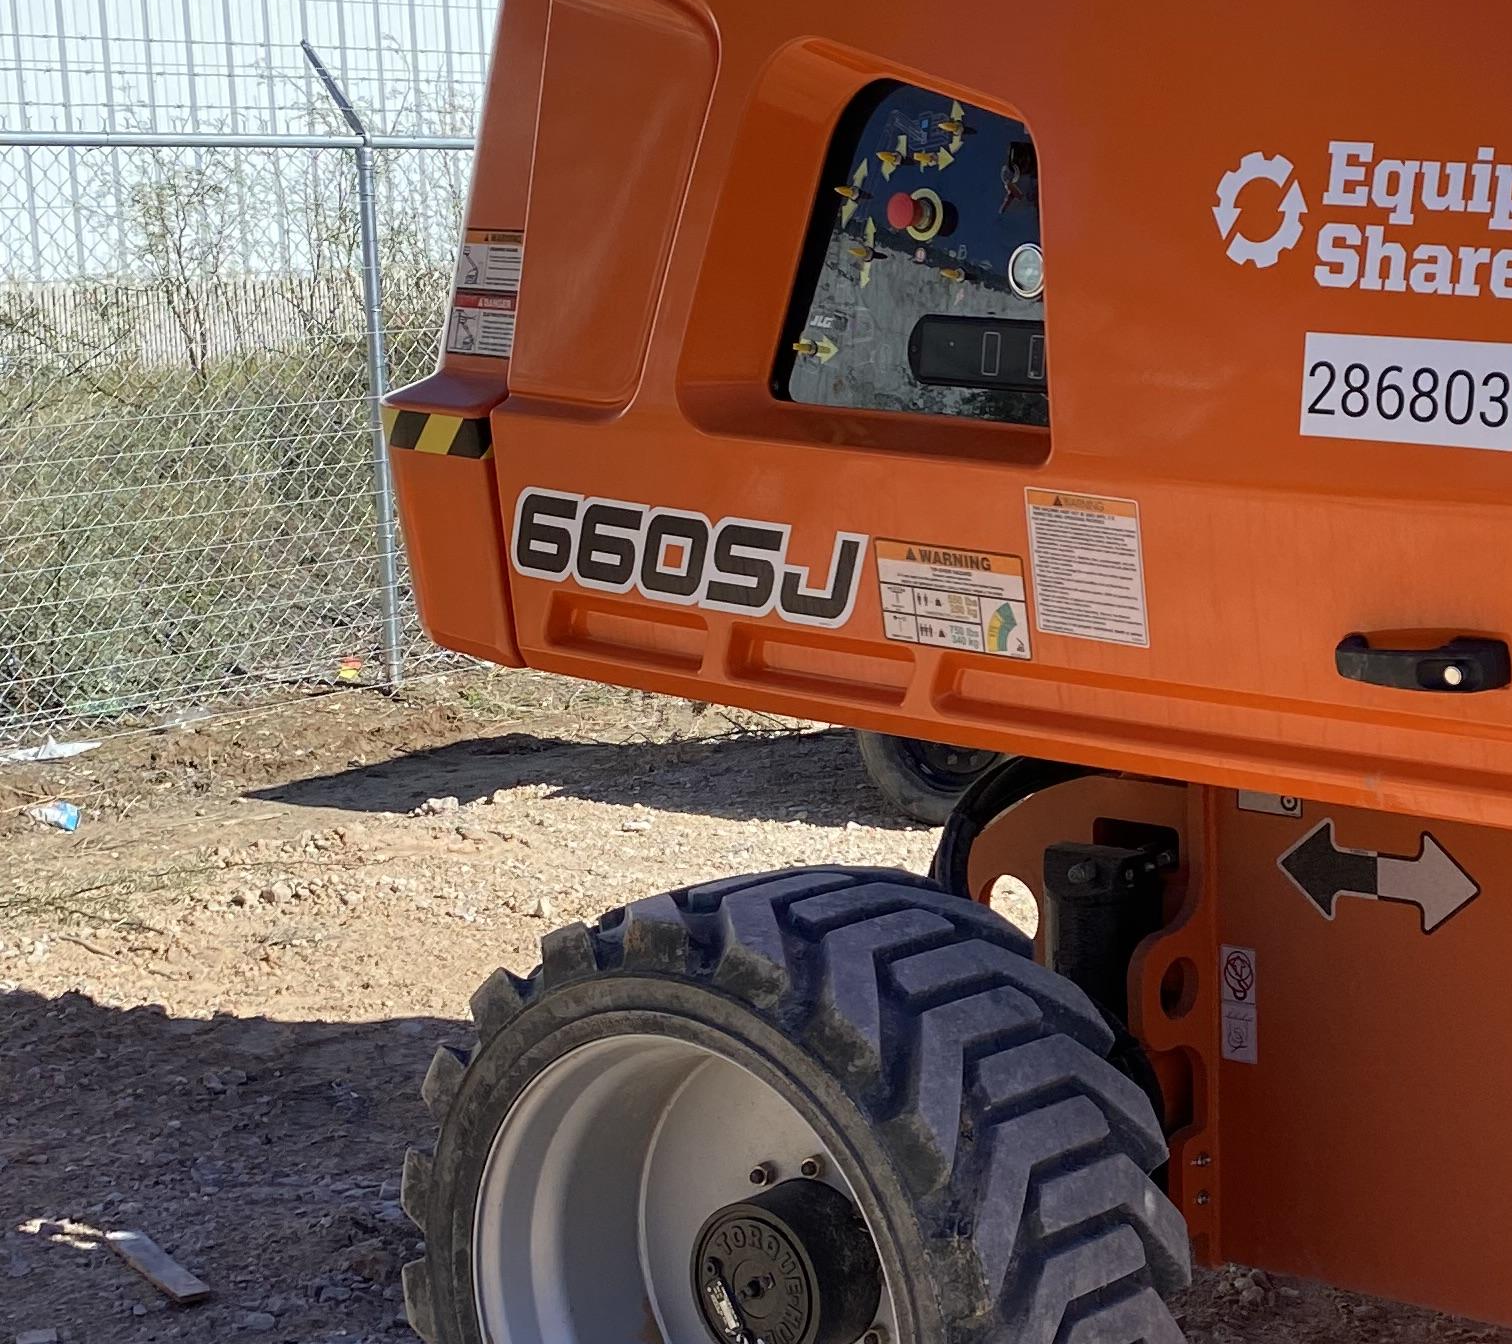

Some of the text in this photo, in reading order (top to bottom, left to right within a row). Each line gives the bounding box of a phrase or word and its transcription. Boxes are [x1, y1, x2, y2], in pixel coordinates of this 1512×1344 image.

[1306, 359, 1512, 430] 286803
[514, 489, 867, 626] 660SJ
[919, 548, 992, 572] WARNING
